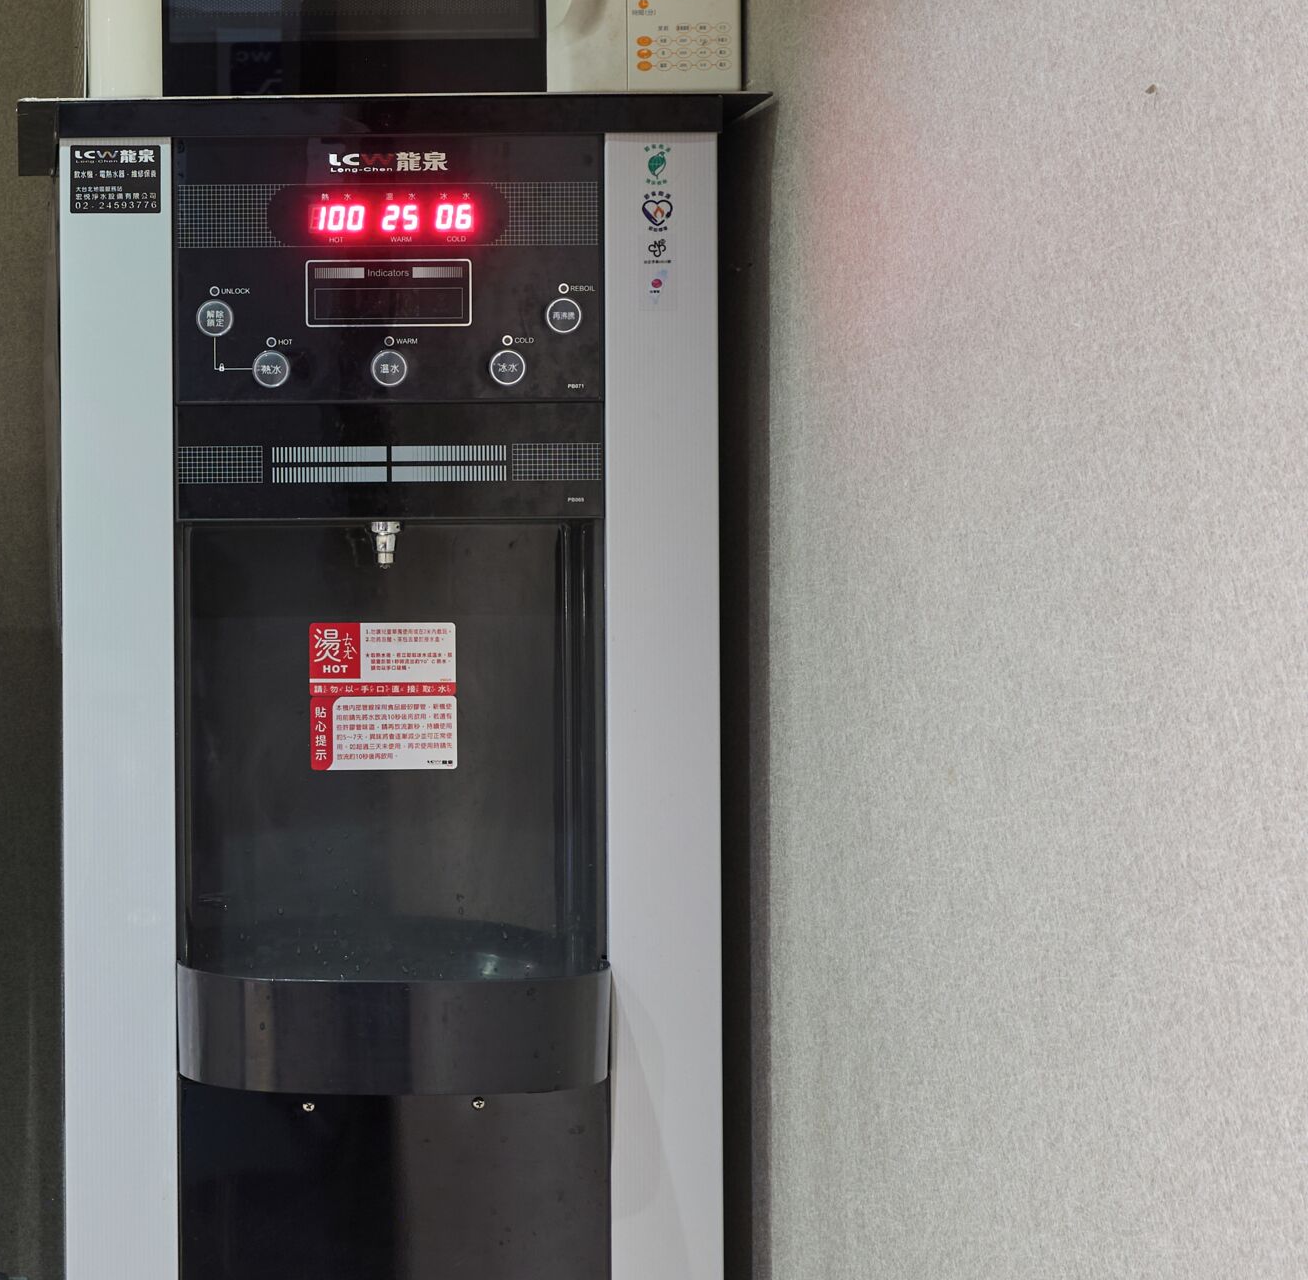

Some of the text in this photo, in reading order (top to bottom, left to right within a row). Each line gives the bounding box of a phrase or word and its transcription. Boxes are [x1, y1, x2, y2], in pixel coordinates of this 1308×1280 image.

[74, 149, 155, 163] LCW 龍泉
[329, 151, 448, 171] LCW 龍泉
[318, 204, 472, 231] 100 25 06
[367, 269, 410, 277] Indicators
[206, 310, 224, 318] 解除
[206, 319, 224, 327] 鎖定
[261, 364, 282, 374] 熱水
[314, 628, 342, 663] 燙
[322, 665, 348, 673] HOT
[315, 706, 327, 761] 貼心提示
